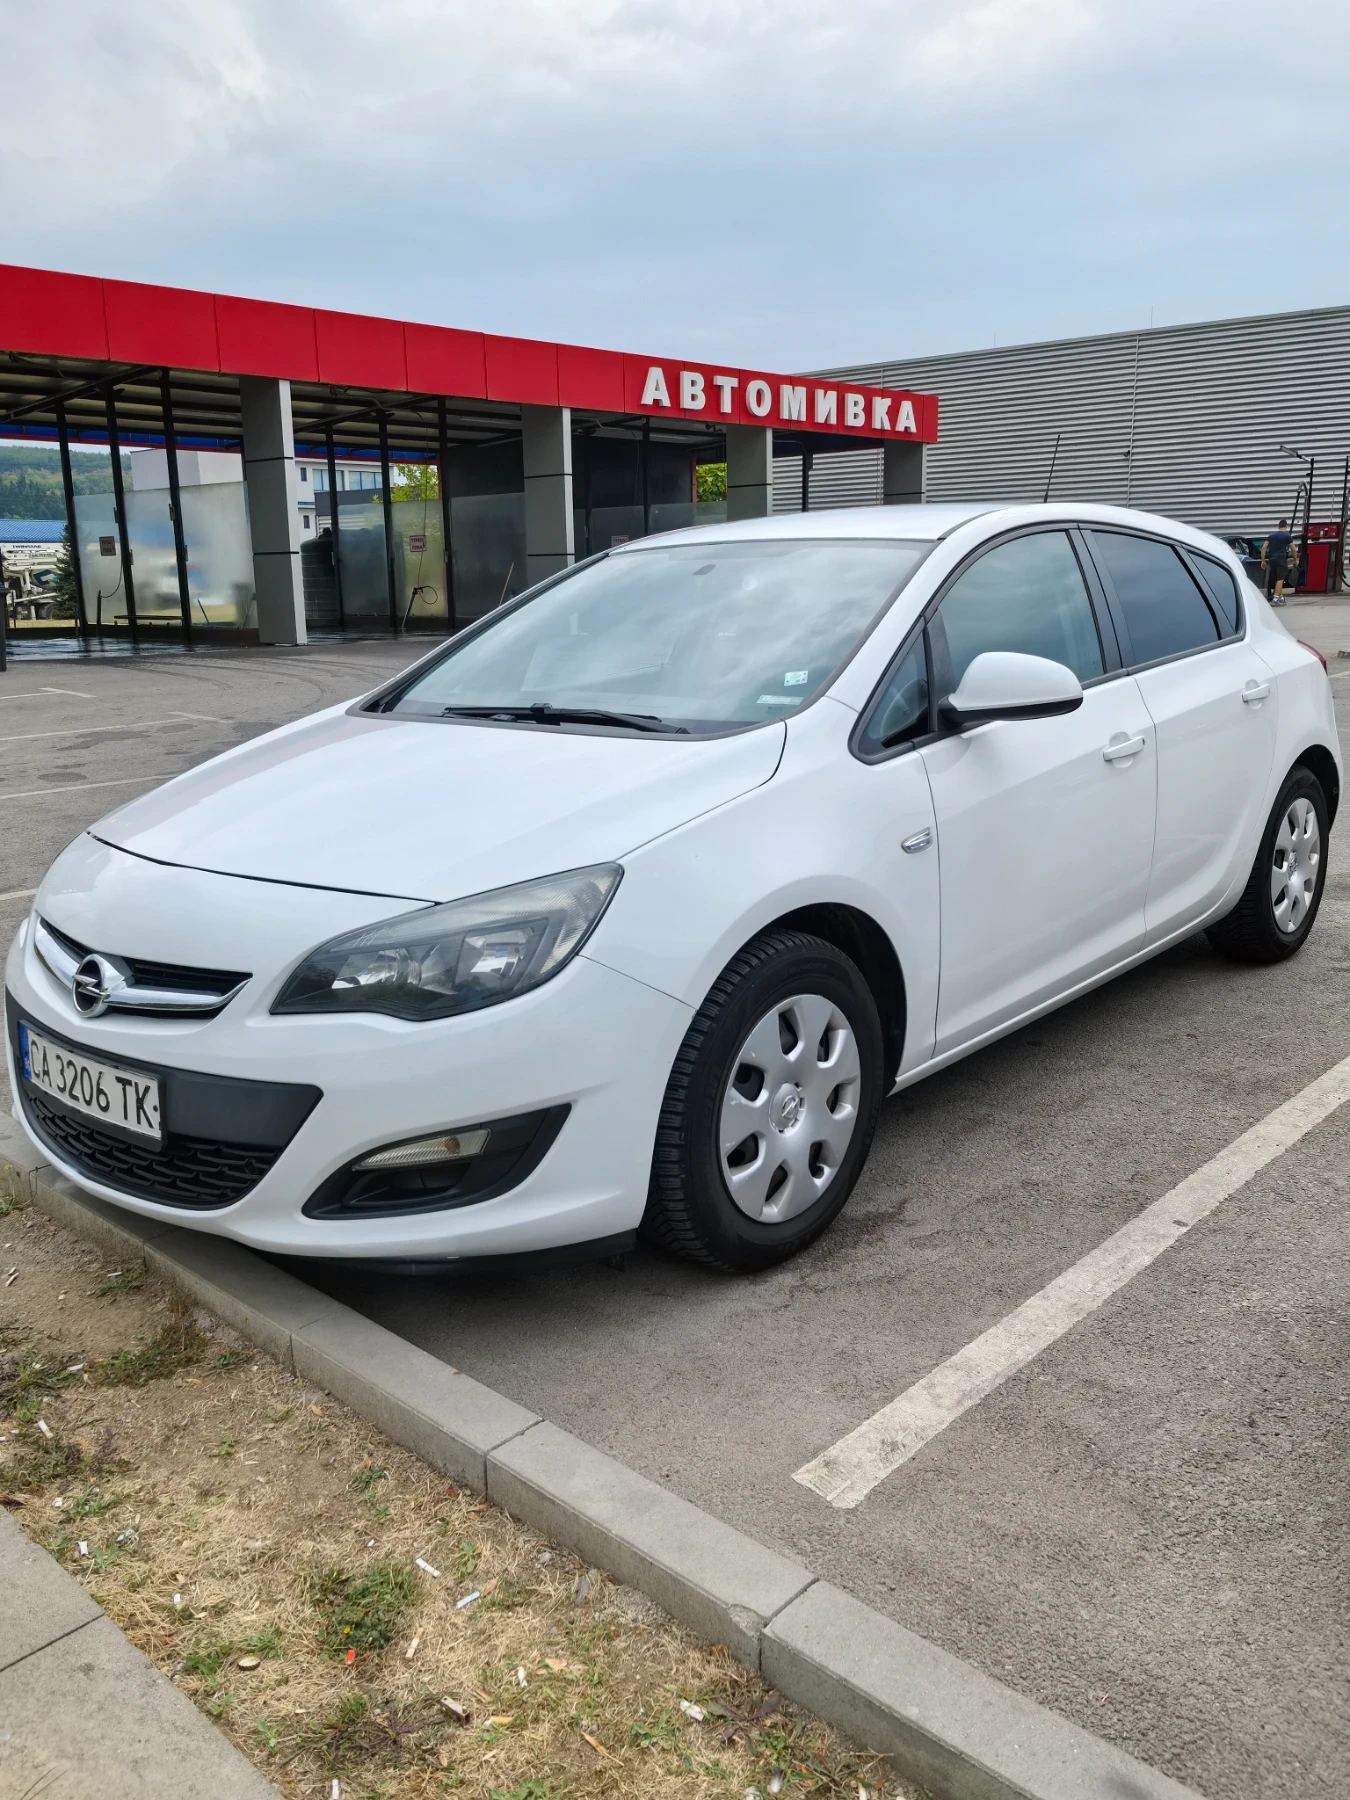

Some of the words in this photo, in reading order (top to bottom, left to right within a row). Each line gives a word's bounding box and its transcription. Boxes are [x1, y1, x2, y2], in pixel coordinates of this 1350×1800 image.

[641, 366, 917, 433] АВТОМИВКА
[30, 1039, 52, 1088] CA
[55, 1053, 110, 1112] 3206
[115, 1076, 155, 1129] TK
